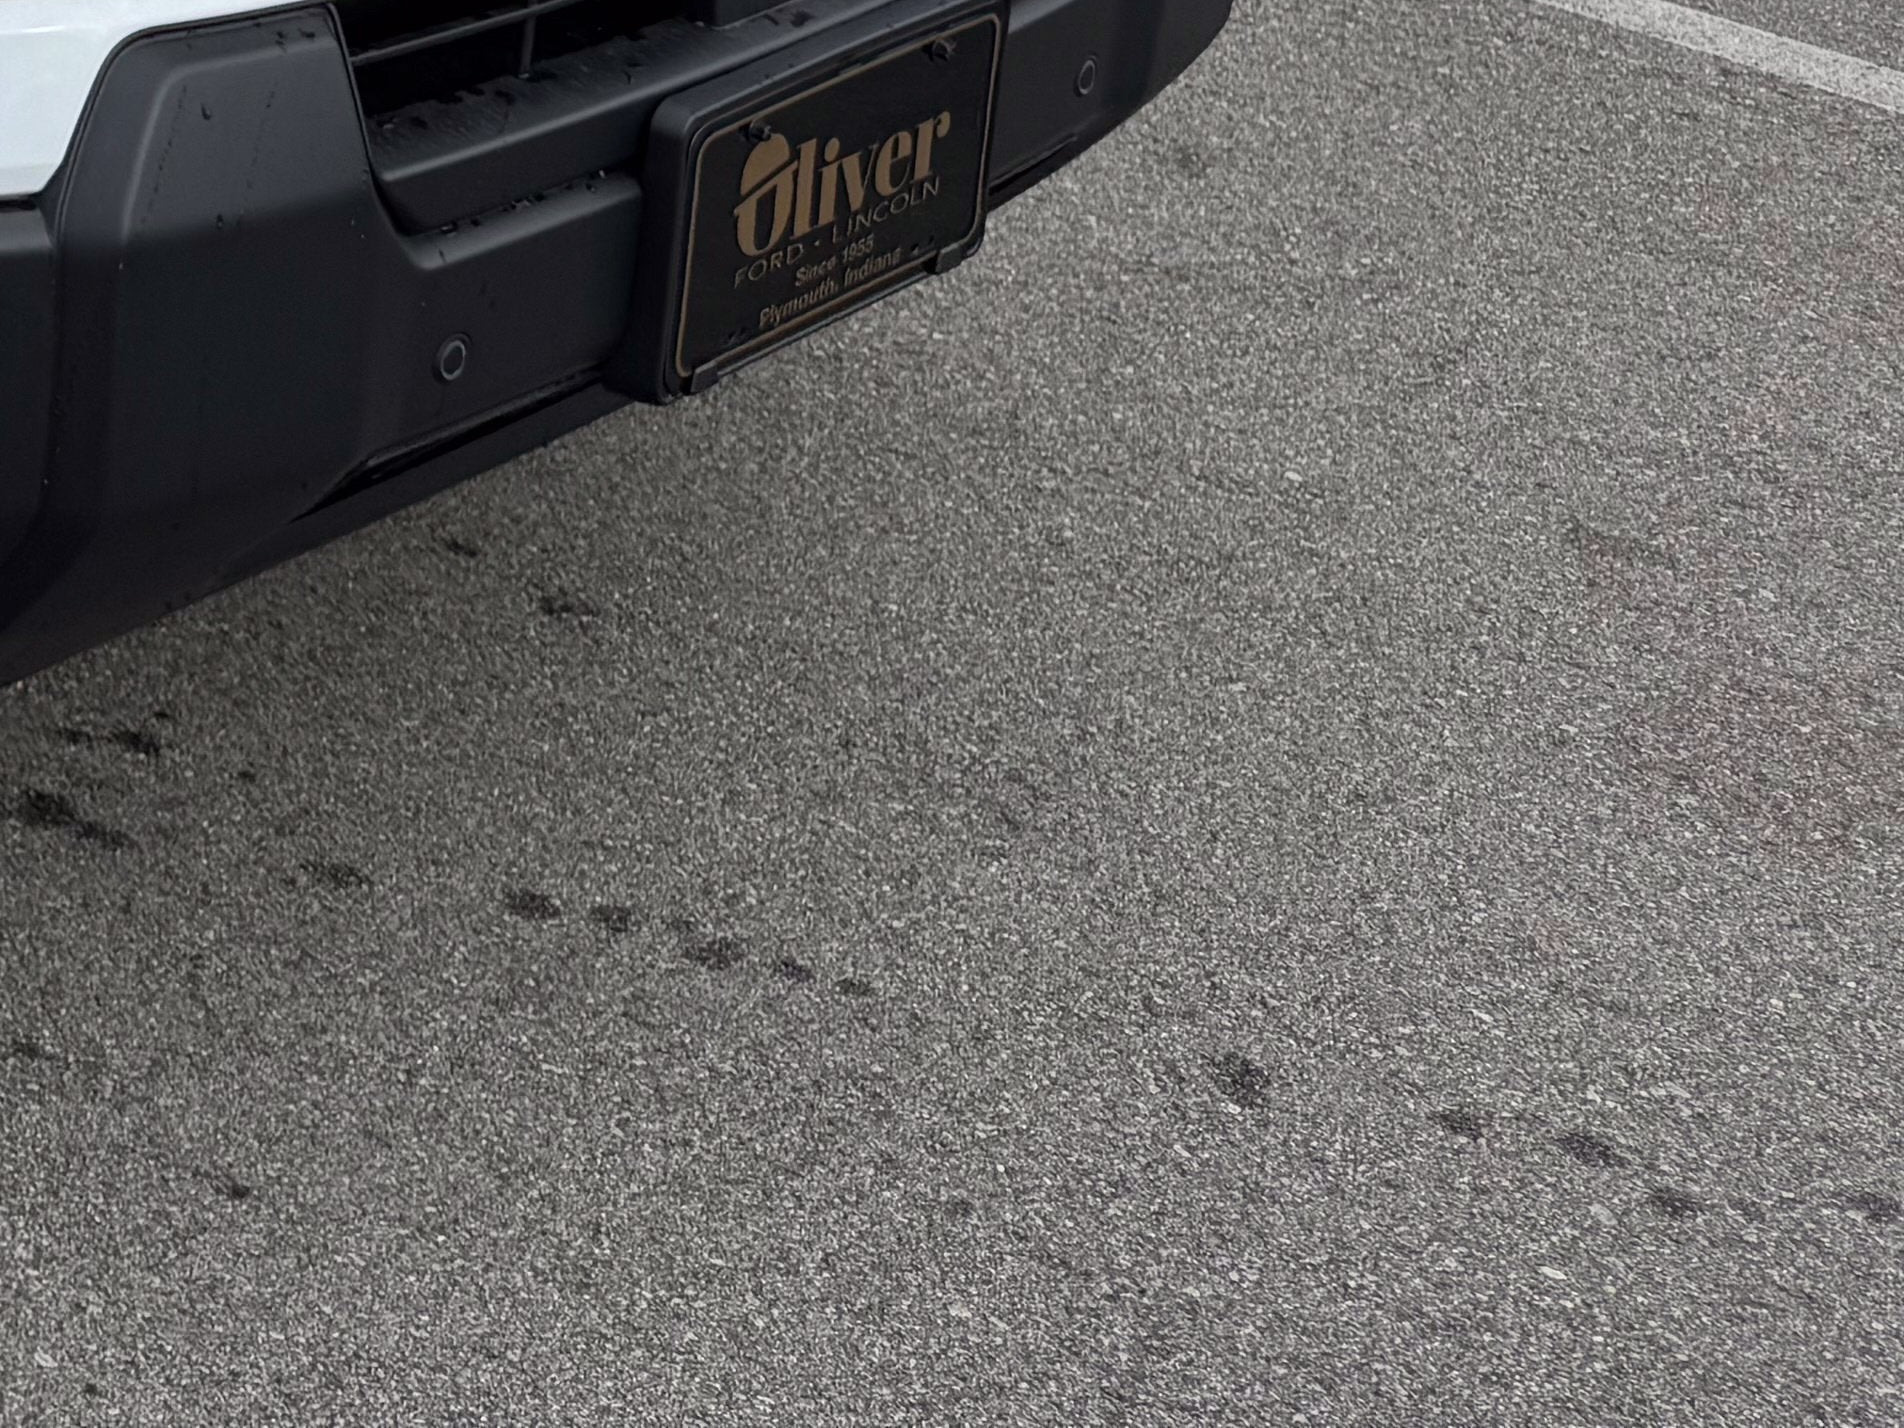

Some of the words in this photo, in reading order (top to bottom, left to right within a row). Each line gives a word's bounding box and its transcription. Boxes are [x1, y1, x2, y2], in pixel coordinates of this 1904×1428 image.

[733, 111, 951, 257] Oliver
[734, 243, 804, 289] FORD
[833, 175, 940, 244] LINCOLN
[795, 255, 836, 287] Since
[843, 233, 875, 261] 1955
[844, 246, 902, 287] Indiana
